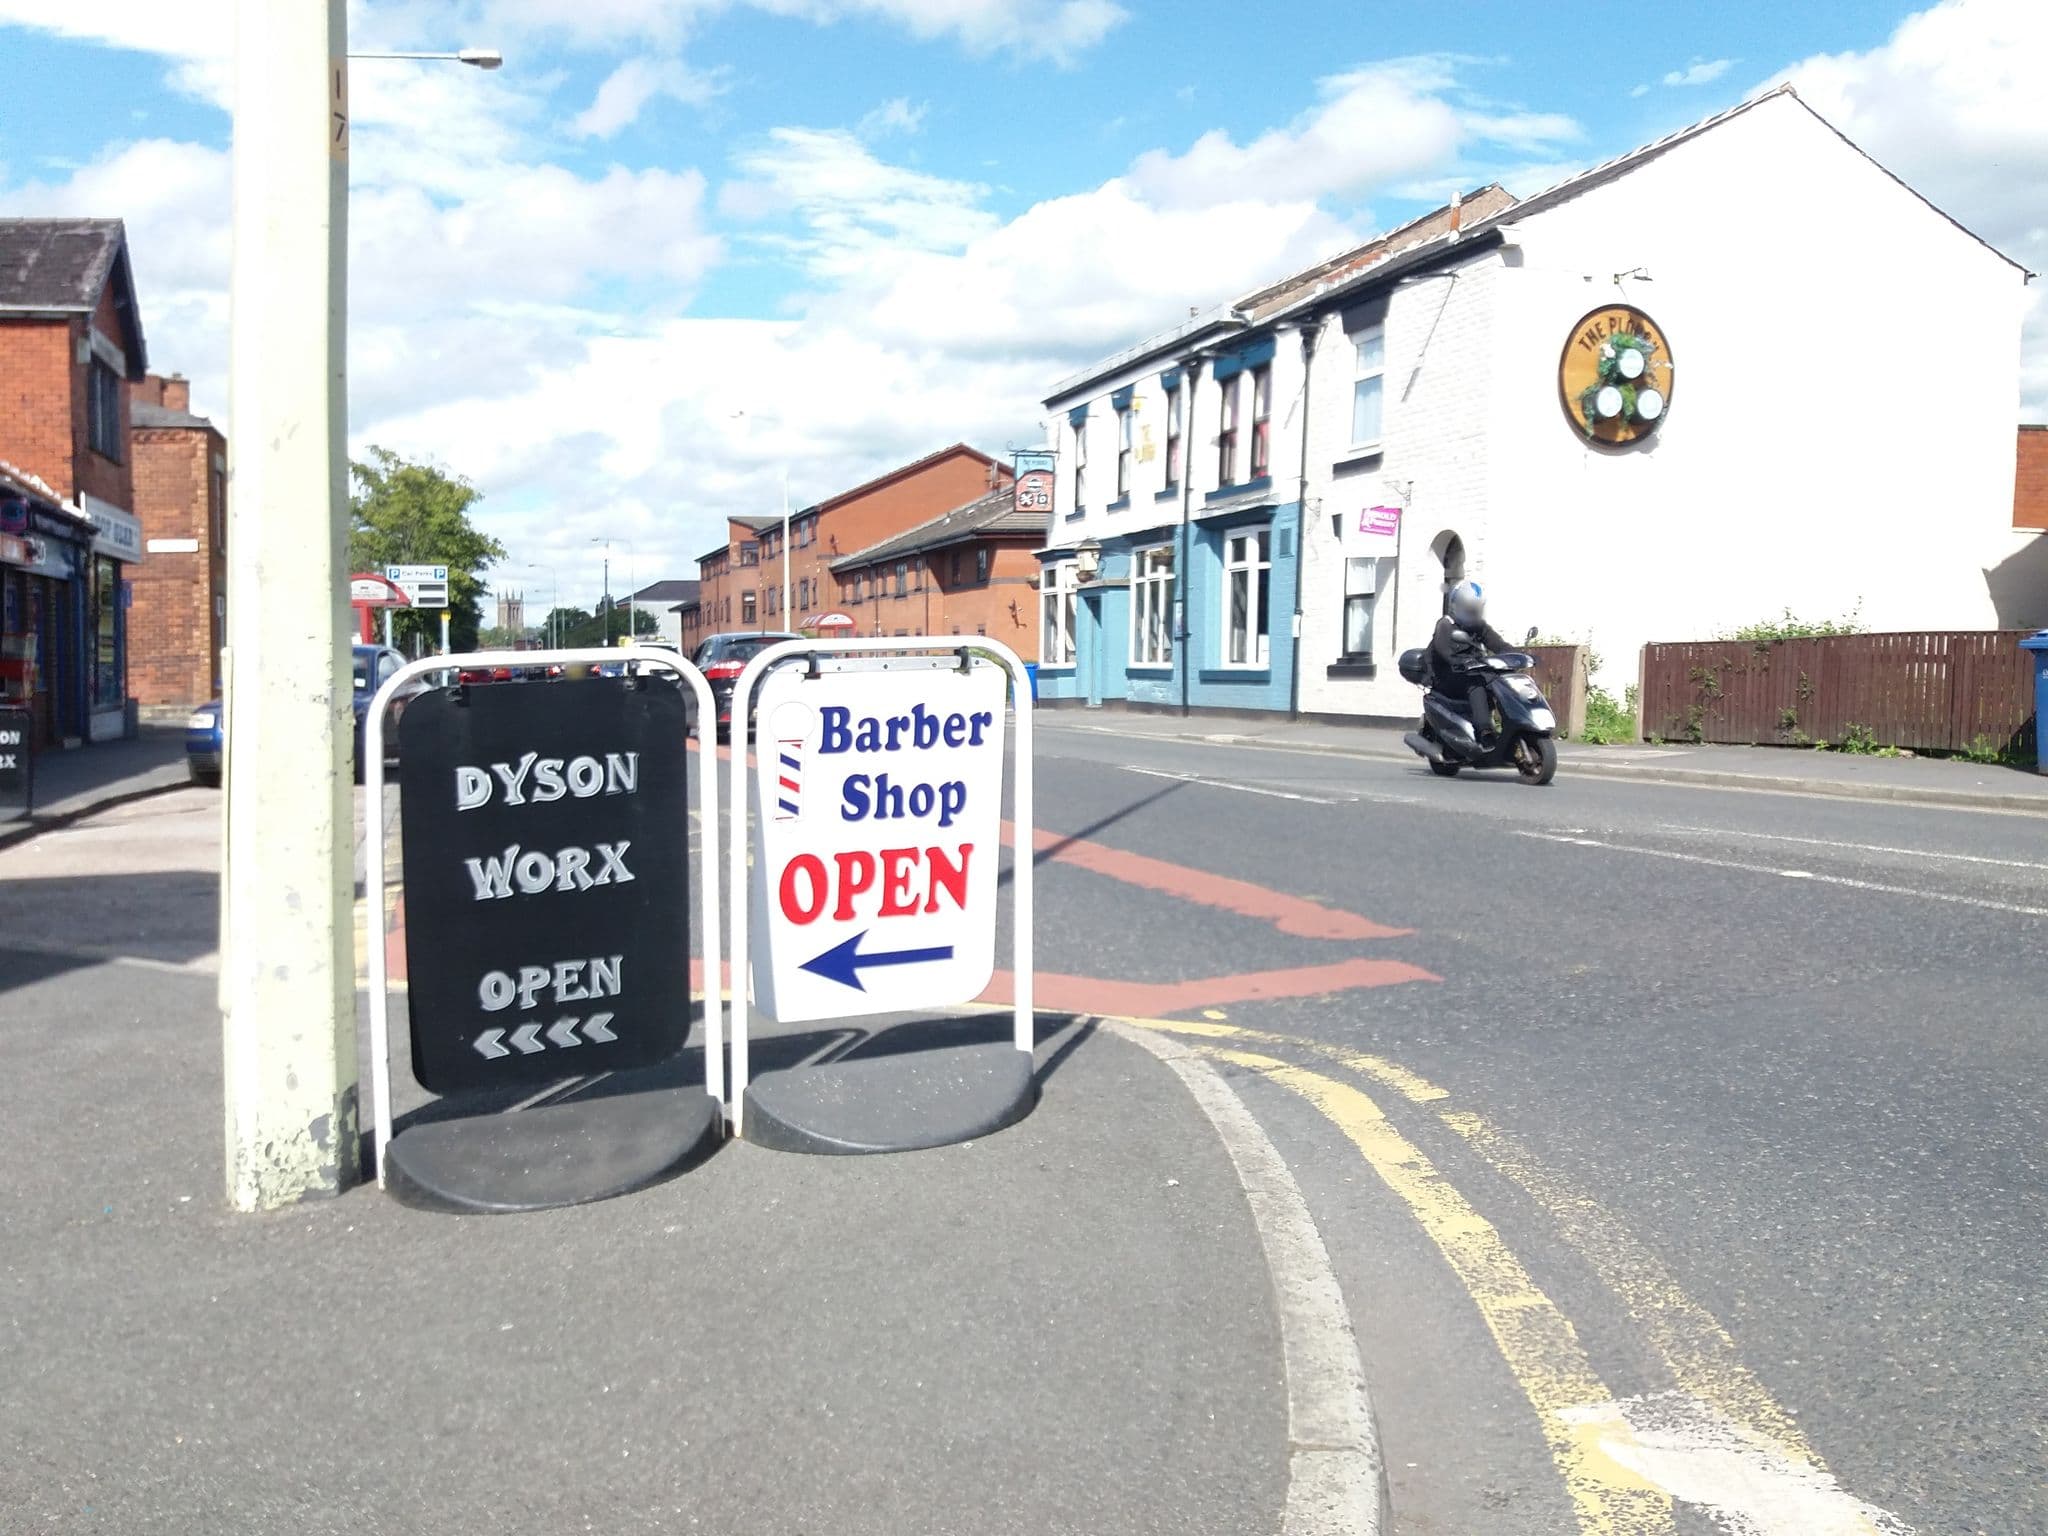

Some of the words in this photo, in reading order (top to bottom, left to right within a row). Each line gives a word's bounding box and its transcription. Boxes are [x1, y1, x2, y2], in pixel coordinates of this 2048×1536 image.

[1579, 322, 1606, 352] THE
[818, 703, 993, 754] Barber
[454, 751, 640, 811] DYSON
[841, 773, 967, 827] Shop
[464, 840, 636, 901] WORX
[778, 842, 975, 926] OPEN
[479, 954, 624, 1011] OPEN
